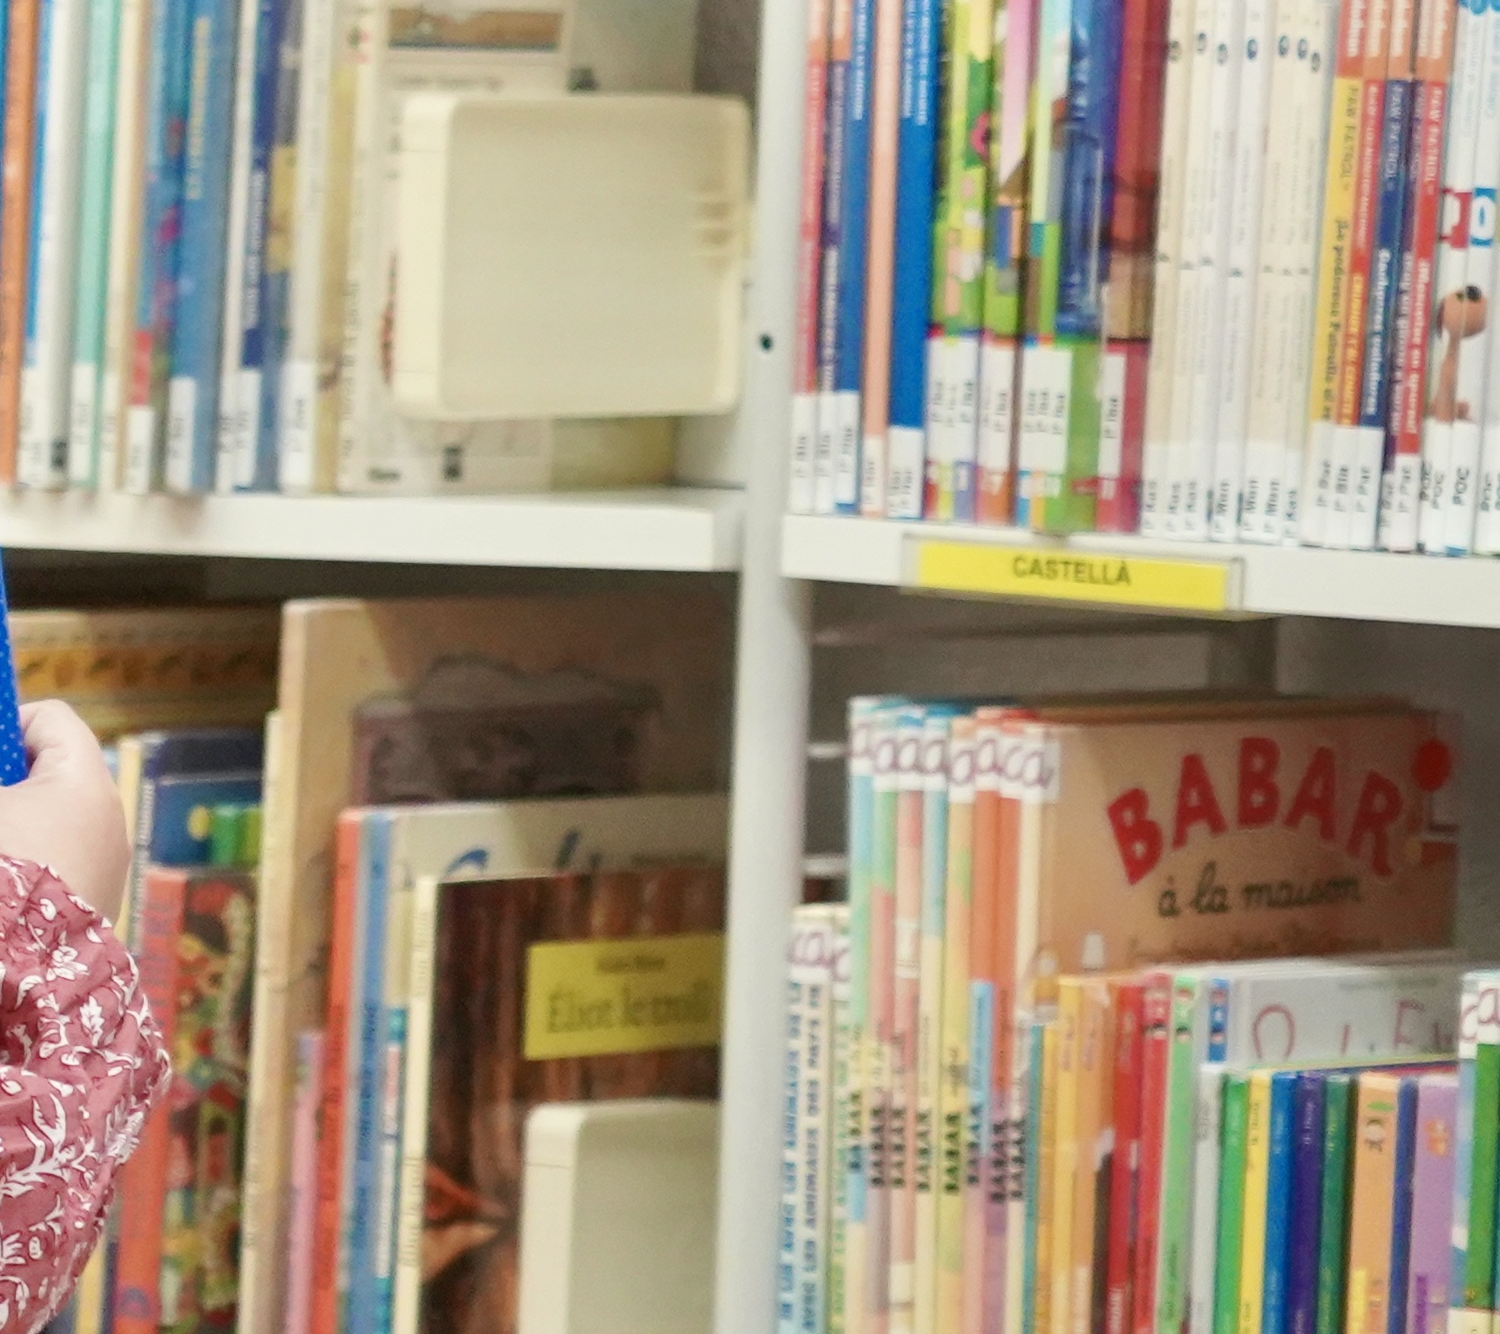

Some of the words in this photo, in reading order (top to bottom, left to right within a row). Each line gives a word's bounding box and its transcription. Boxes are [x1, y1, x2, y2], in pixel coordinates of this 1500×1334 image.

[1013, 556, 1133, 587] CASTELLÀ
[1106, 736, 1404, 887] BABAR
[1190, 861, 1232, 915] la
[1242, 873, 1364, 910] maison
